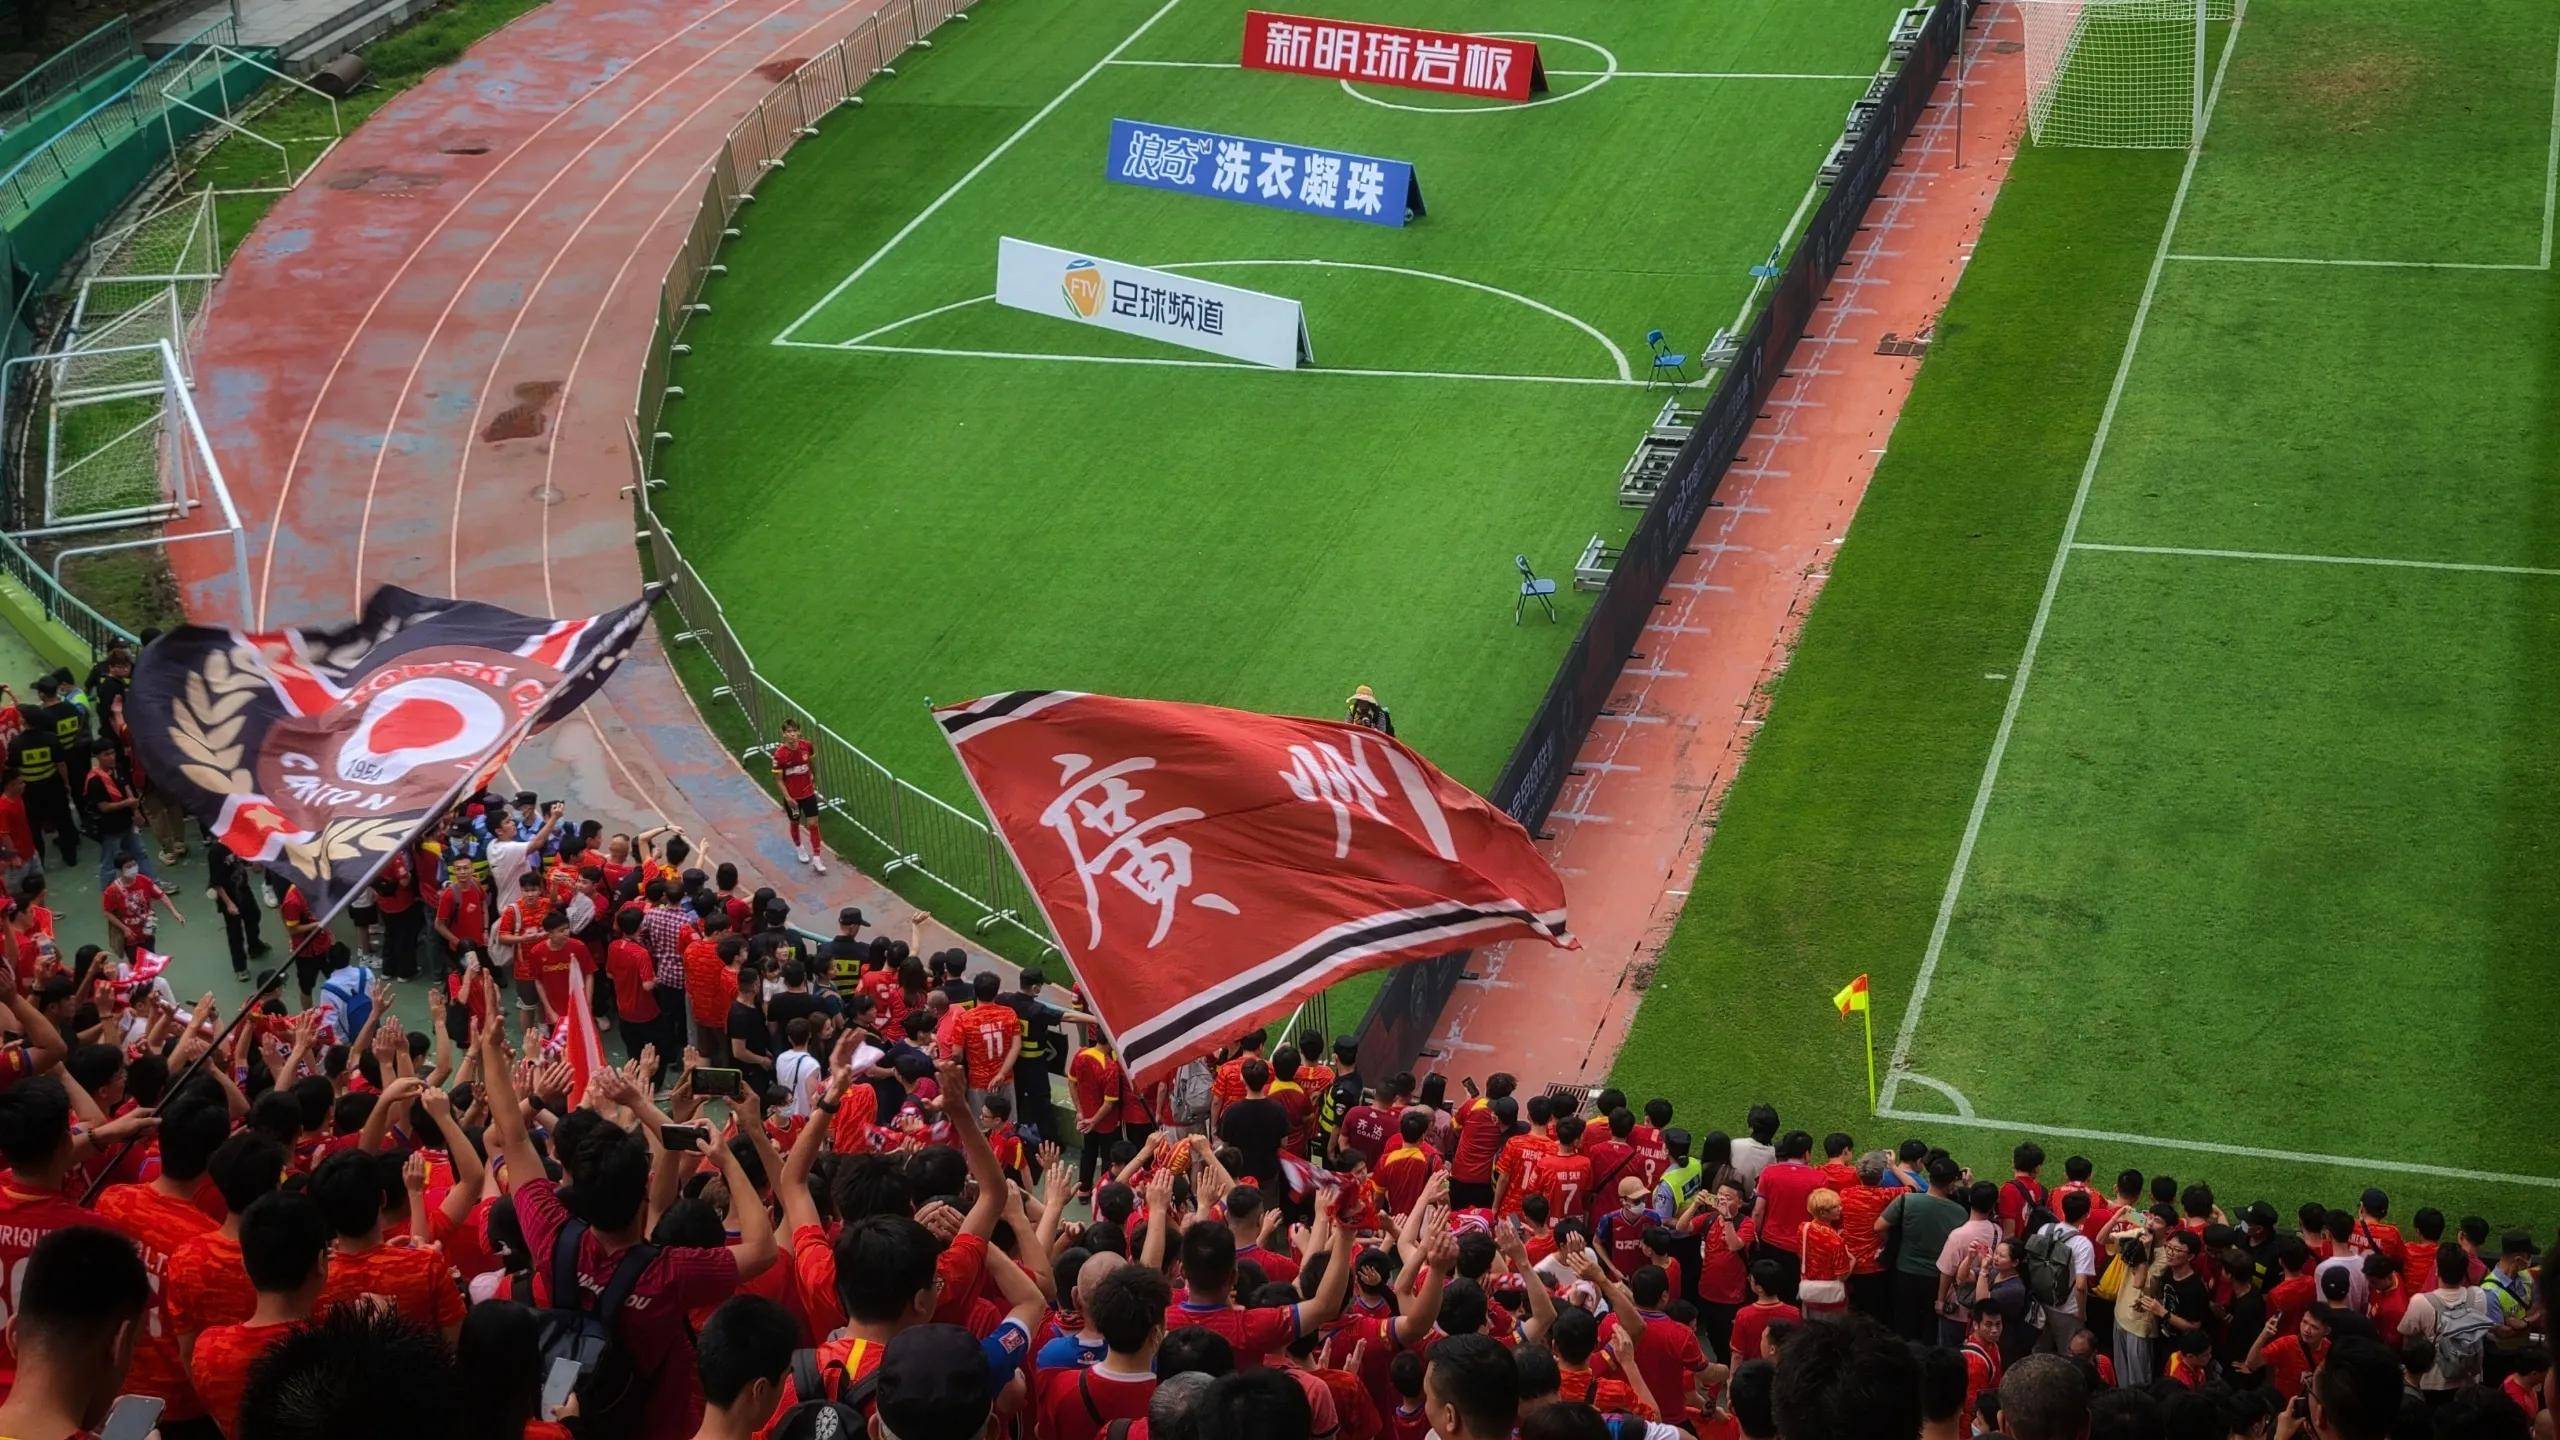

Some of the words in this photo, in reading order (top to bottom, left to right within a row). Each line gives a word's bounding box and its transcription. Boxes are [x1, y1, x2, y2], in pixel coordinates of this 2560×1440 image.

[1265, 22, 1513, 91] 新明珠岩板
[1122, 130, 1199, 185] 浪奇
[1211, 139, 1385, 216] 洗衣凝珠
[1070, 277, 1098, 299] FTV
[1111, 279, 1224, 336] 足球频道
[280, 751, 398, 811] CANTON
[344, 758, 385, 782] 1954
[983, 1031, 1003, 1060] 11
[1356, 1129, 1381, 1140] COACH
[1561, 1183, 1578, 1215] 7
